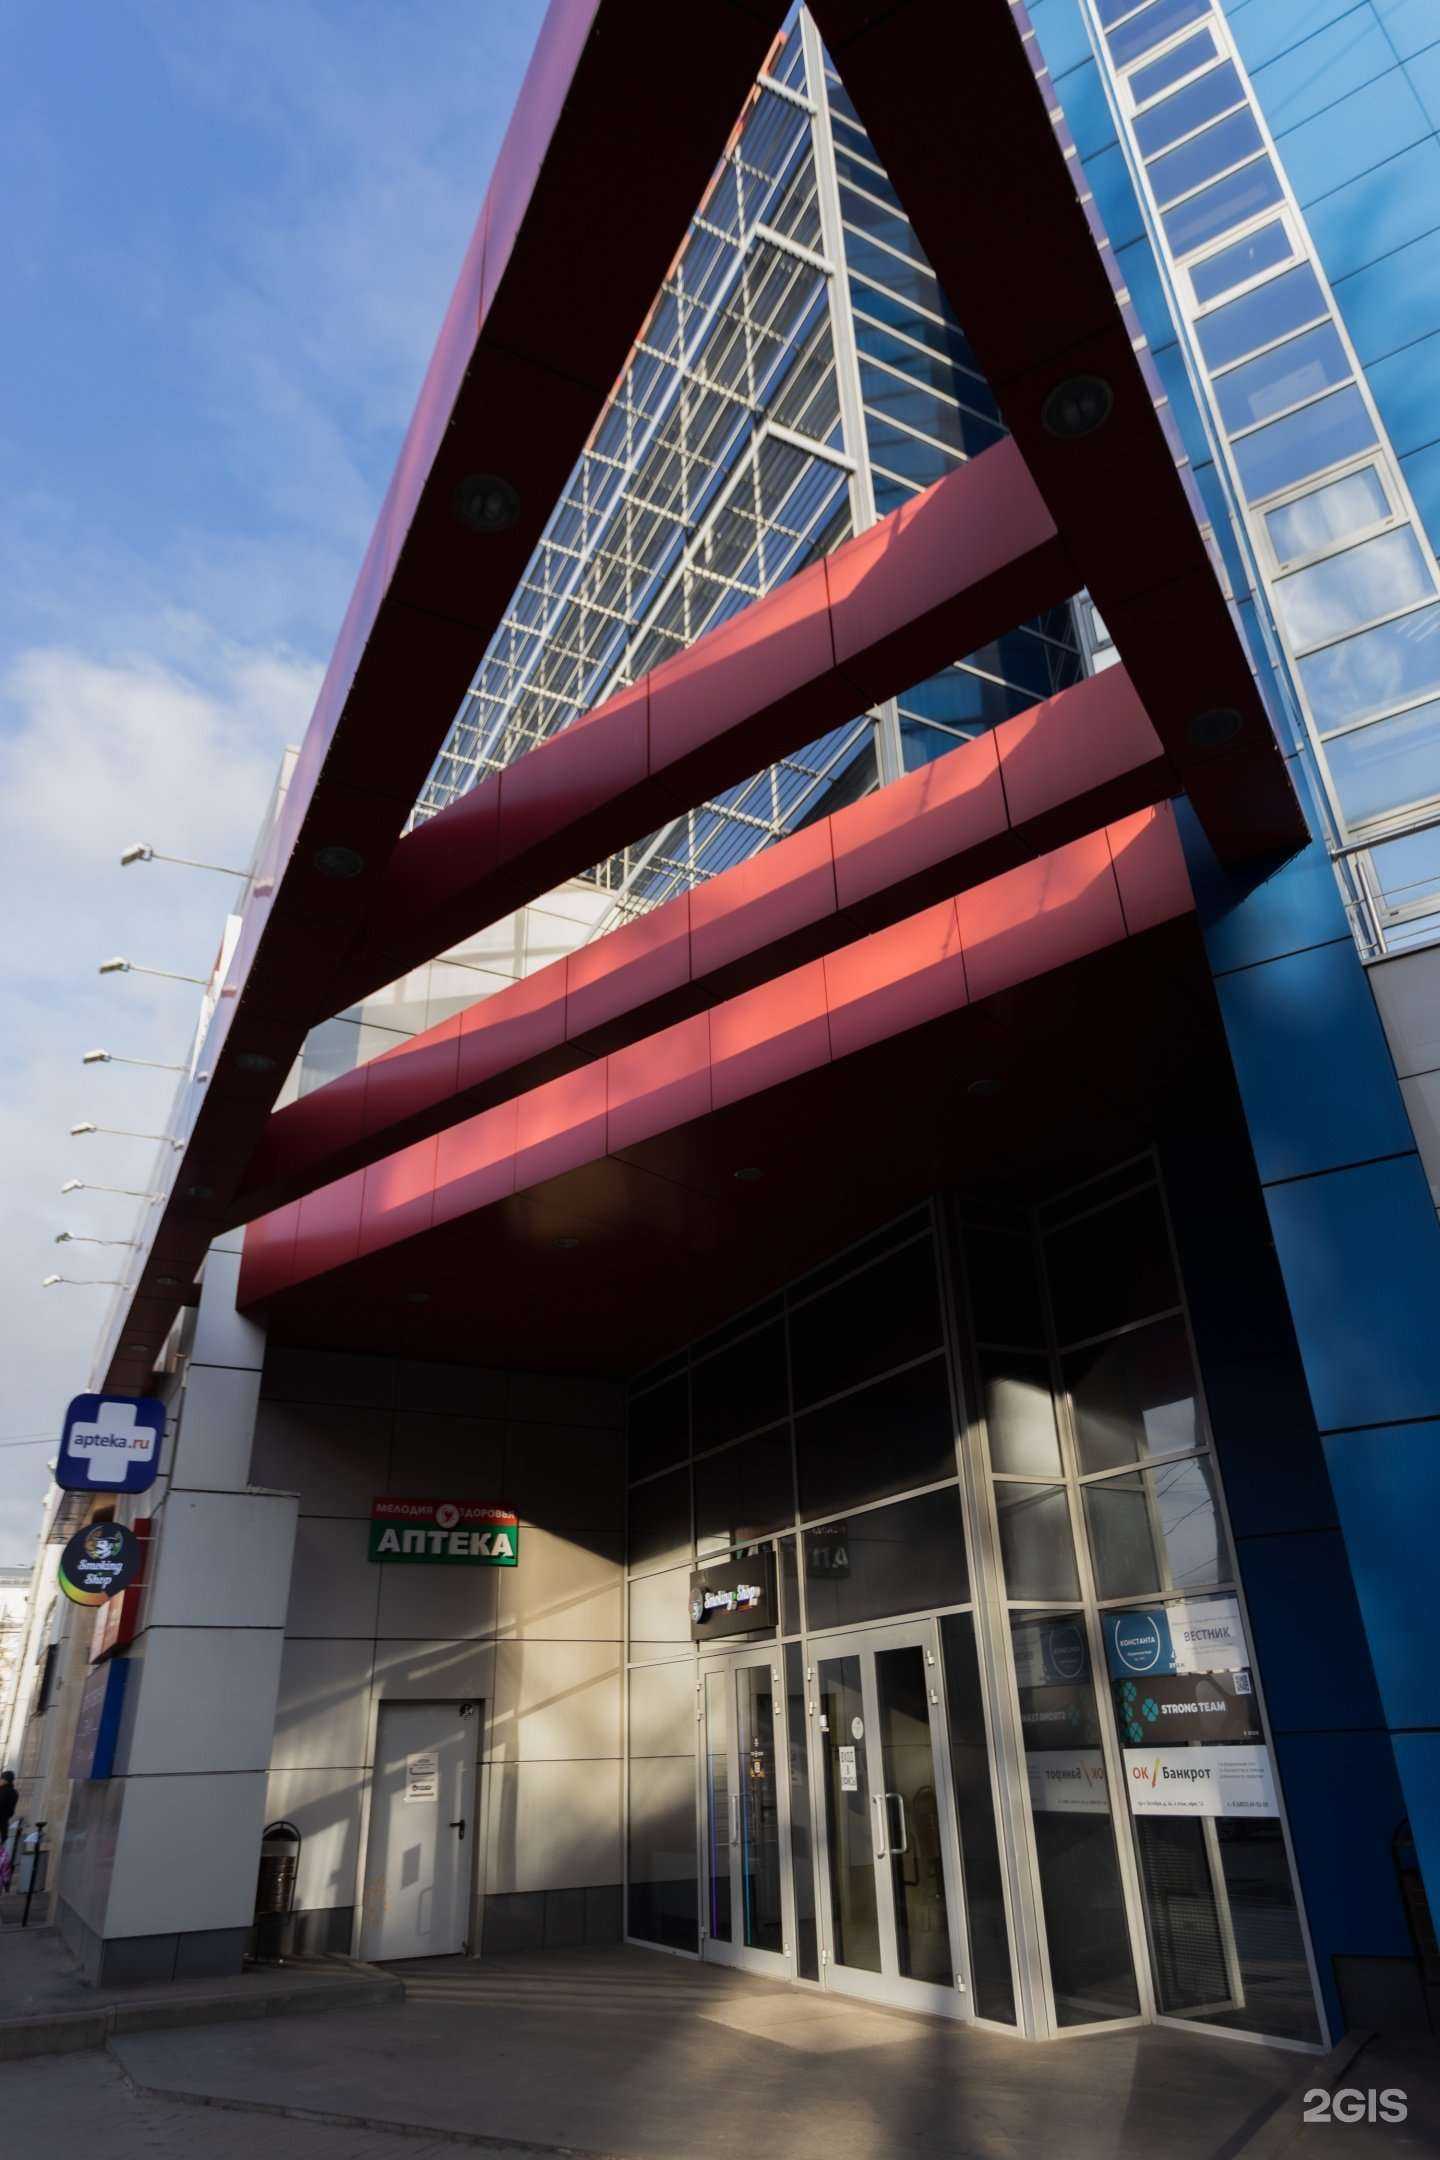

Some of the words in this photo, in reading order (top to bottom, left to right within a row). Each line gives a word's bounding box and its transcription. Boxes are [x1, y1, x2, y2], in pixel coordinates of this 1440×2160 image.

[74, 1433, 150, 1450] apteka.ru
[376, 1502, 433, 1515] МЕЛОДИЯ
[459, 1507, 516, 1519] ЗДОРОВЬЯ
[377, 1528, 514, 1557] АПТЕКА
[77, 1560, 123, 1575] Smoking
[84, 1573, 112, 1589] Shop
[1119, 1636, 1156, 1647] КОНСТАНТА
[1184, 1626, 1231, 1642] ВЕСТНИК
[1161, 1703, 1198, 1715] STRONG
[1199, 1701, 1227, 1713] TEAM
[1162, 1766, 1211, 1782] Банкрот
